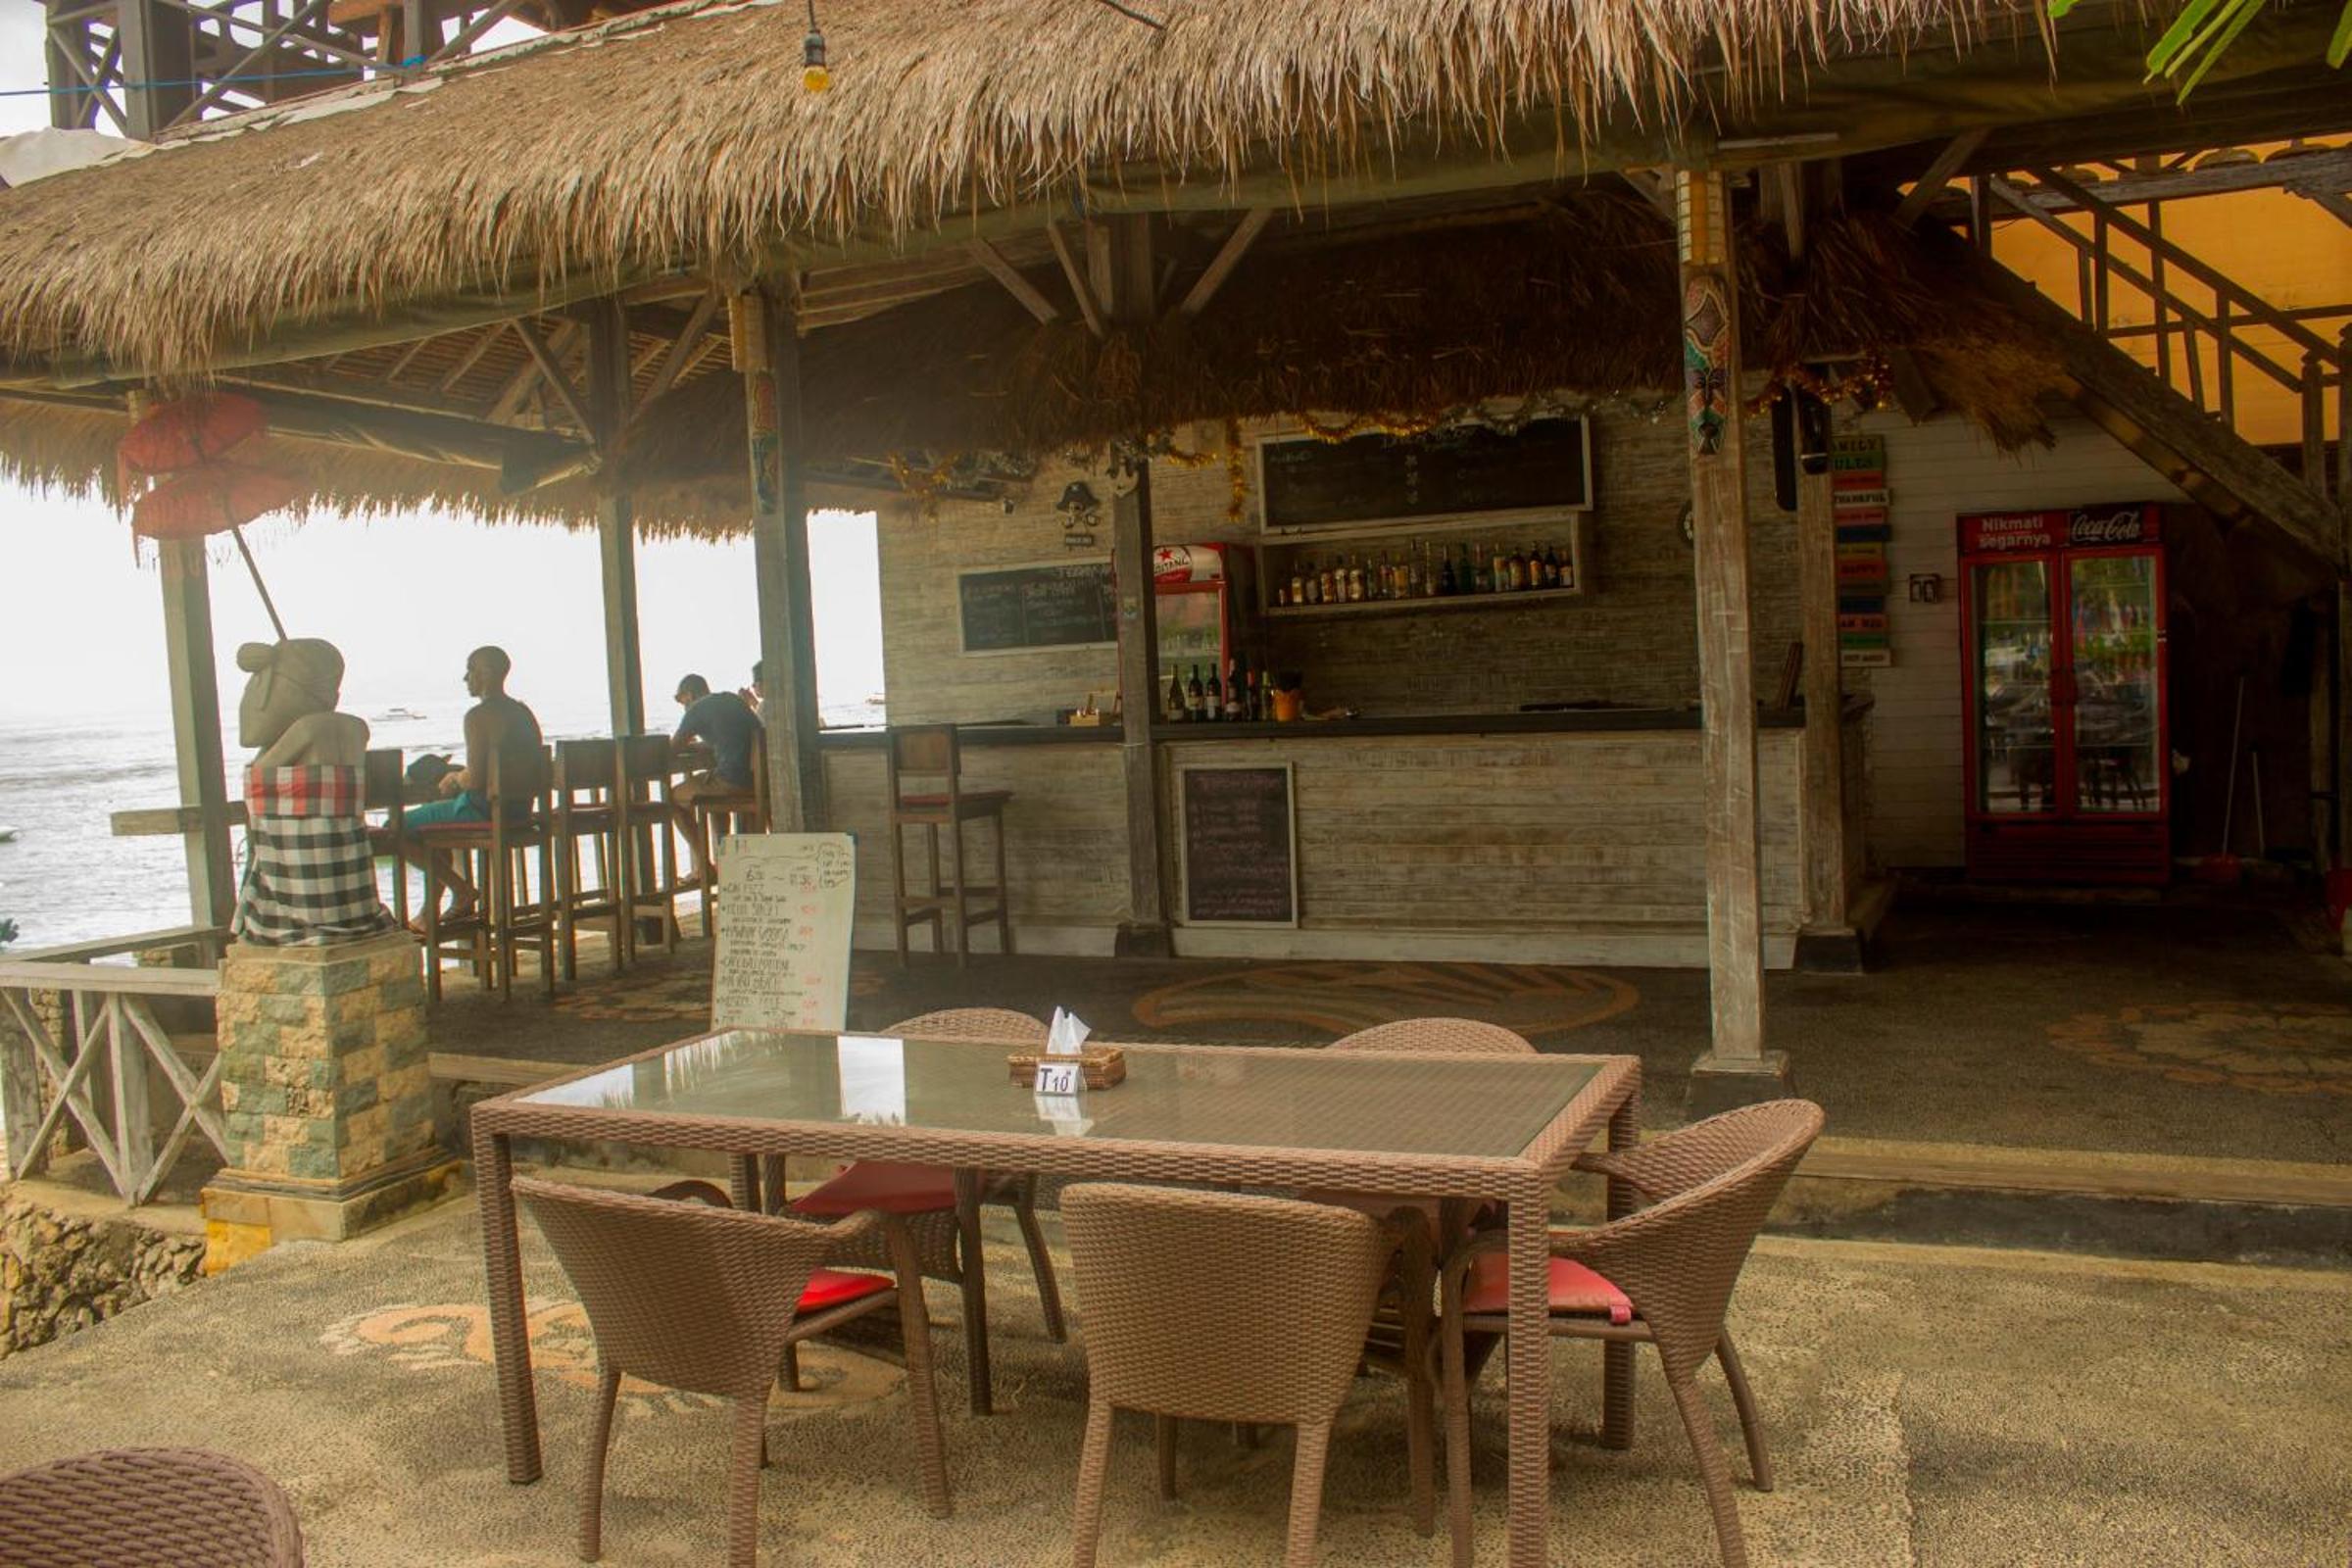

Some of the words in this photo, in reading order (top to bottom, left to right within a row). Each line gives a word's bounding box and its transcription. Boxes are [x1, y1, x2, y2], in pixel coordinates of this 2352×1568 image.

[1835, 458, 1873, 469] ULES
[1982, 514, 2044, 532] Nikmati
[2073, 512, 2140, 542] Coca-Cola
